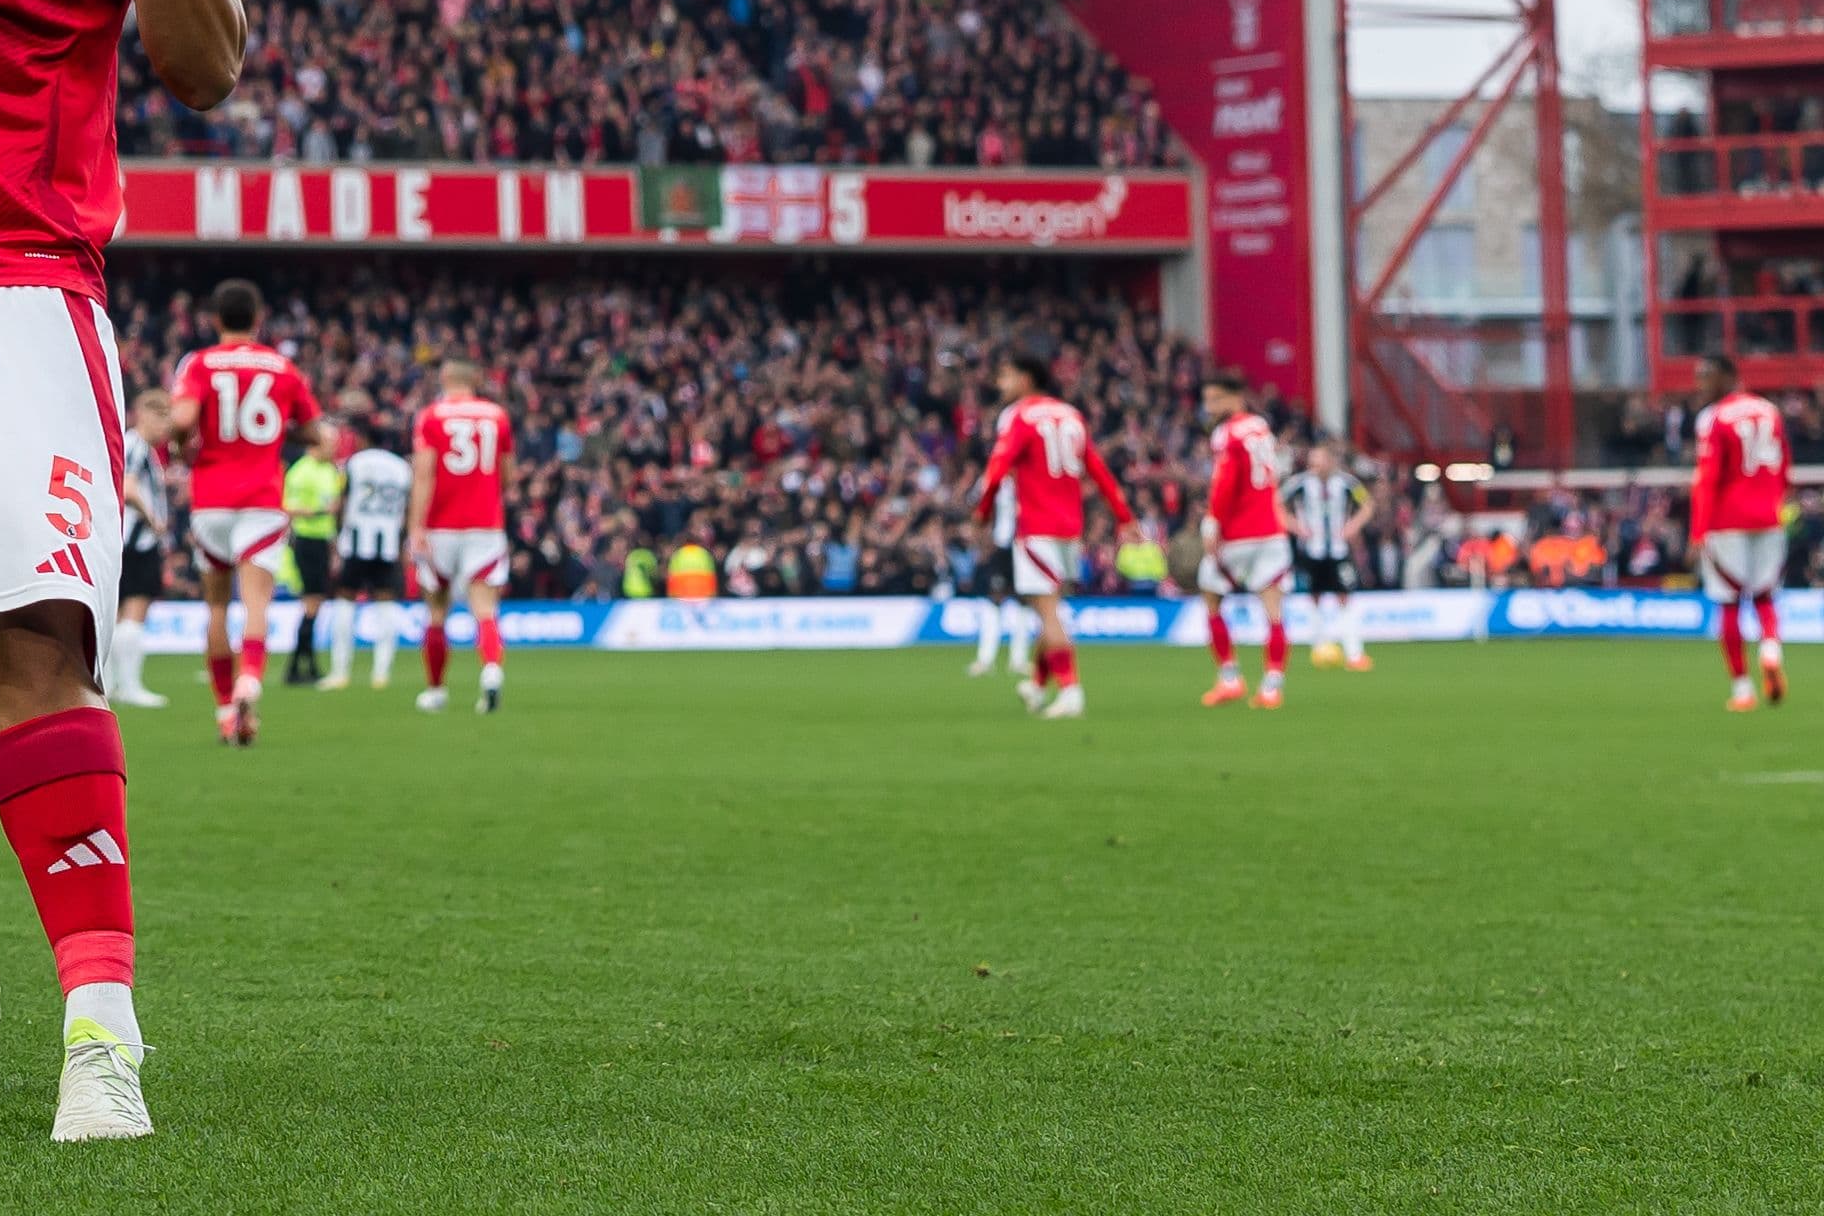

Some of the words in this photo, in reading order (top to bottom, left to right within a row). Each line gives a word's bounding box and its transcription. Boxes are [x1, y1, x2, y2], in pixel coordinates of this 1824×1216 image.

[196, 167, 434, 241] MADE
[497, 169, 585, 242] IN
[211, 371, 282, 446] 16
[443, 418, 498, 476] 31
[45, 454, 94, 540] 5
